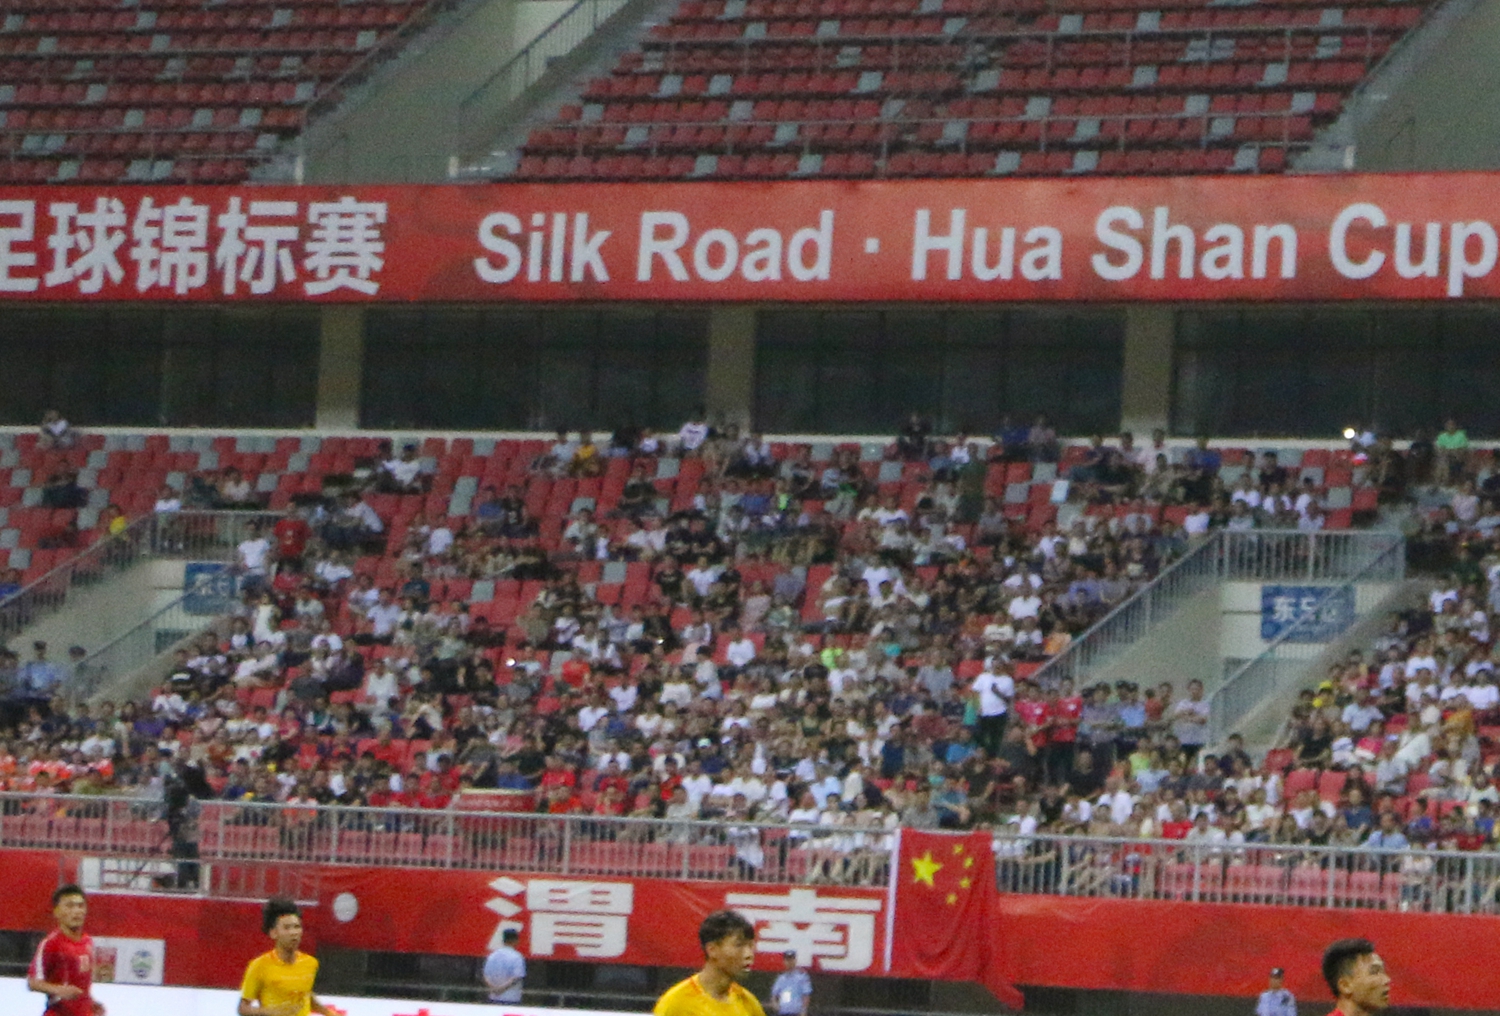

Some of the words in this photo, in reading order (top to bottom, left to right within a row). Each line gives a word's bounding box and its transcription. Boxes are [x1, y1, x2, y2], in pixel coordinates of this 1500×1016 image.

[474, 210, 610, 284] Silk
[638, 209, 835, 283] Road
[910, 208, 1064, 281] Hua
[1090, 205, 1298, 282] Shan
[1328, 202, 1499, 297] Cup
